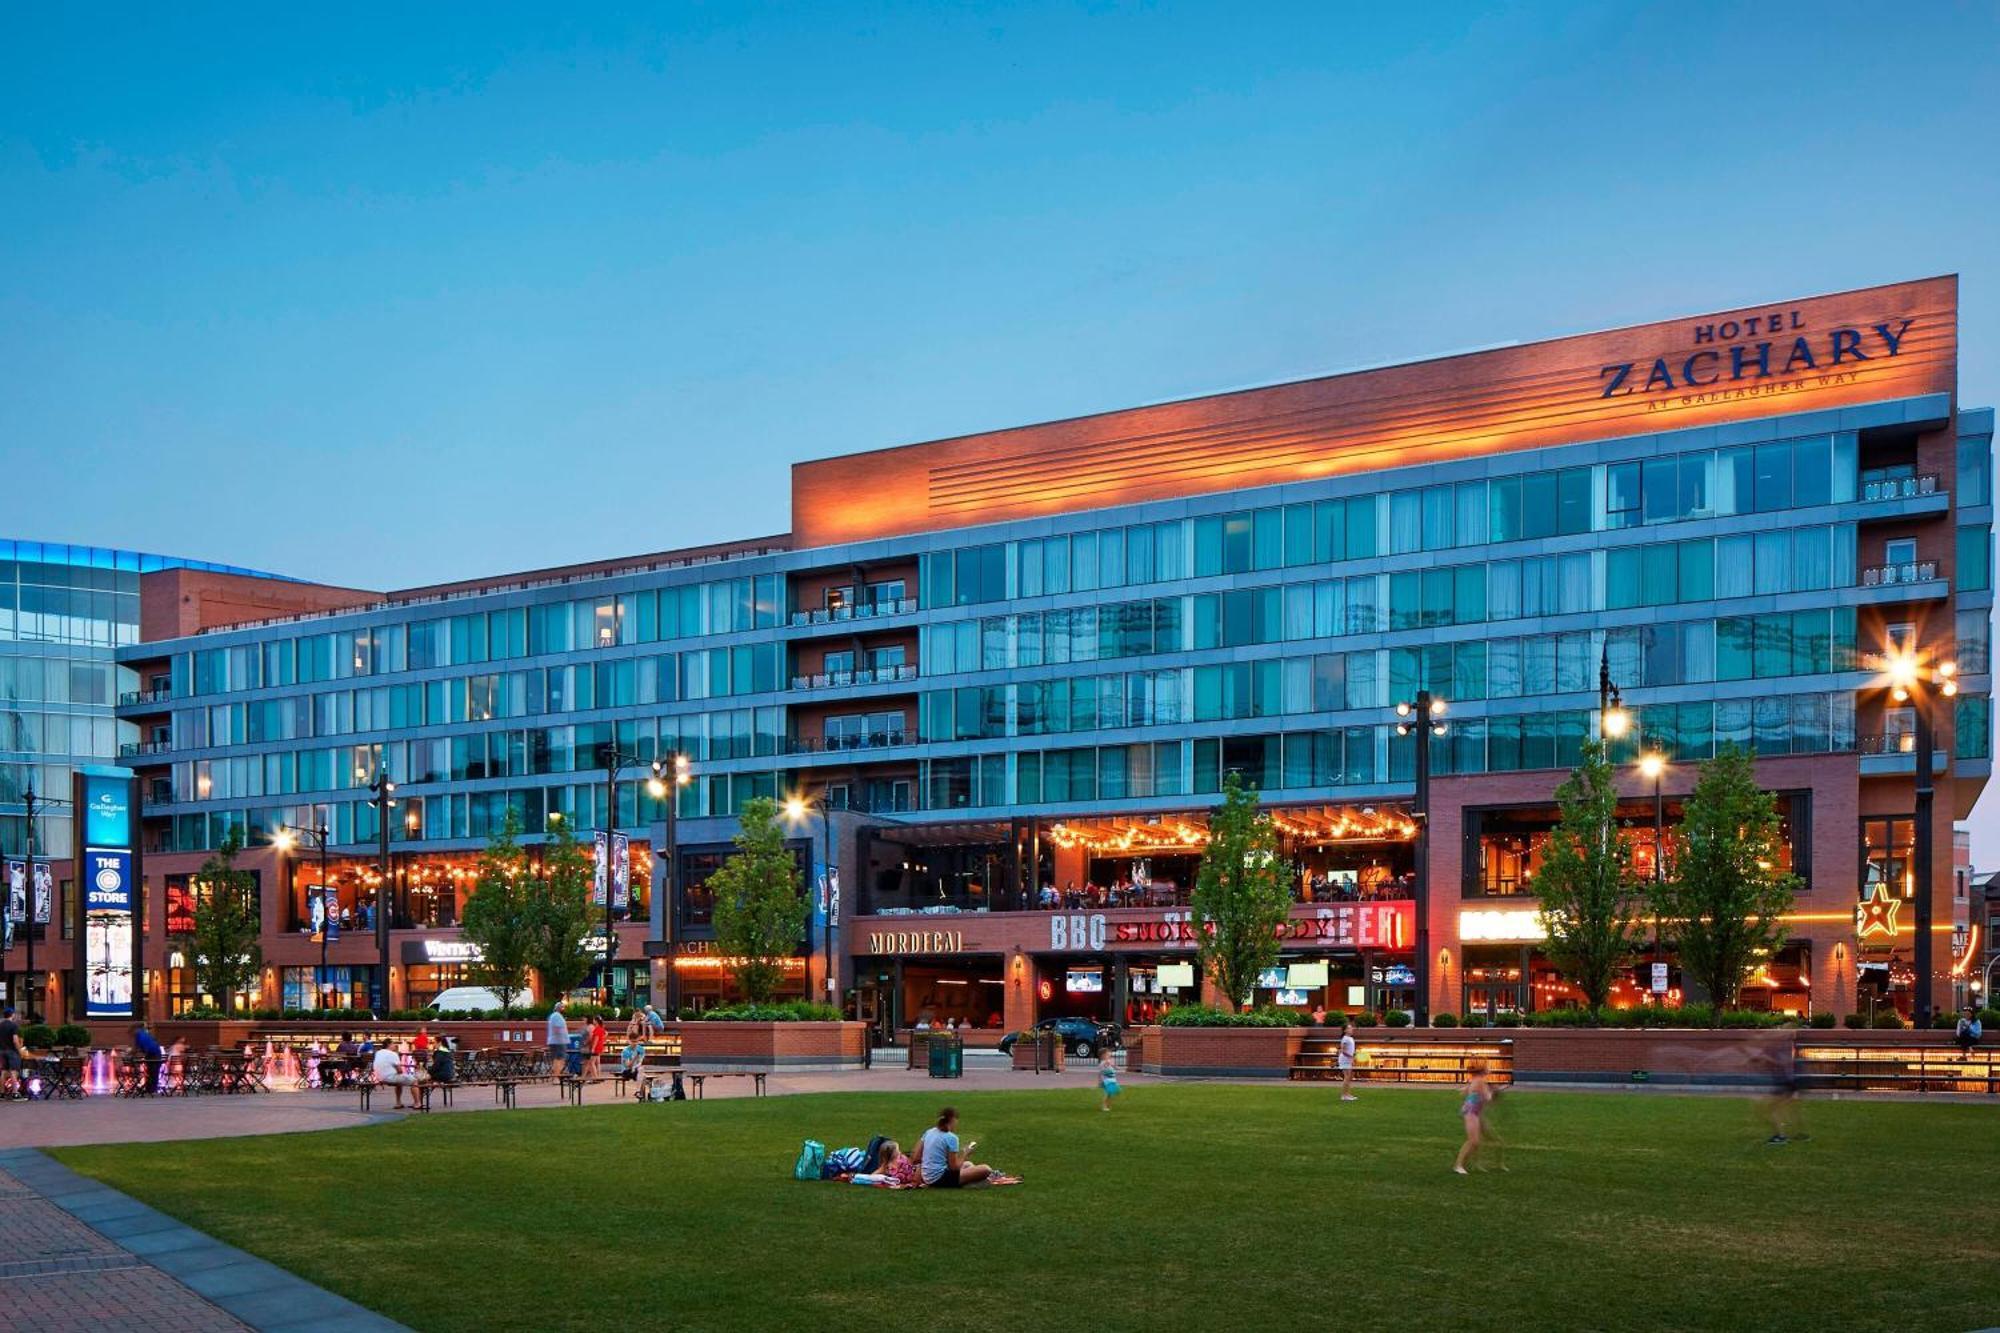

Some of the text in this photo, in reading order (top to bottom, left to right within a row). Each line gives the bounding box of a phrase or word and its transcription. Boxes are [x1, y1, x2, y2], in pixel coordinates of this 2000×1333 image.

[1694, 311, 1806, 345] HOTEL
[1600, 319, 1915, 398] ZACHARY
[1648, 371, 1859, 411] AT GALLAGHER WAY
[96, 858, 120, 869] THE
[89, 891, 128, 904] STORE
[870, 930, 962, 954] MORDECAI
[1051, 914, 1107, 951] BBQ
[1116, 921, 1217, 942] SMOK
[1316, 907, 1396, 945] BEER
